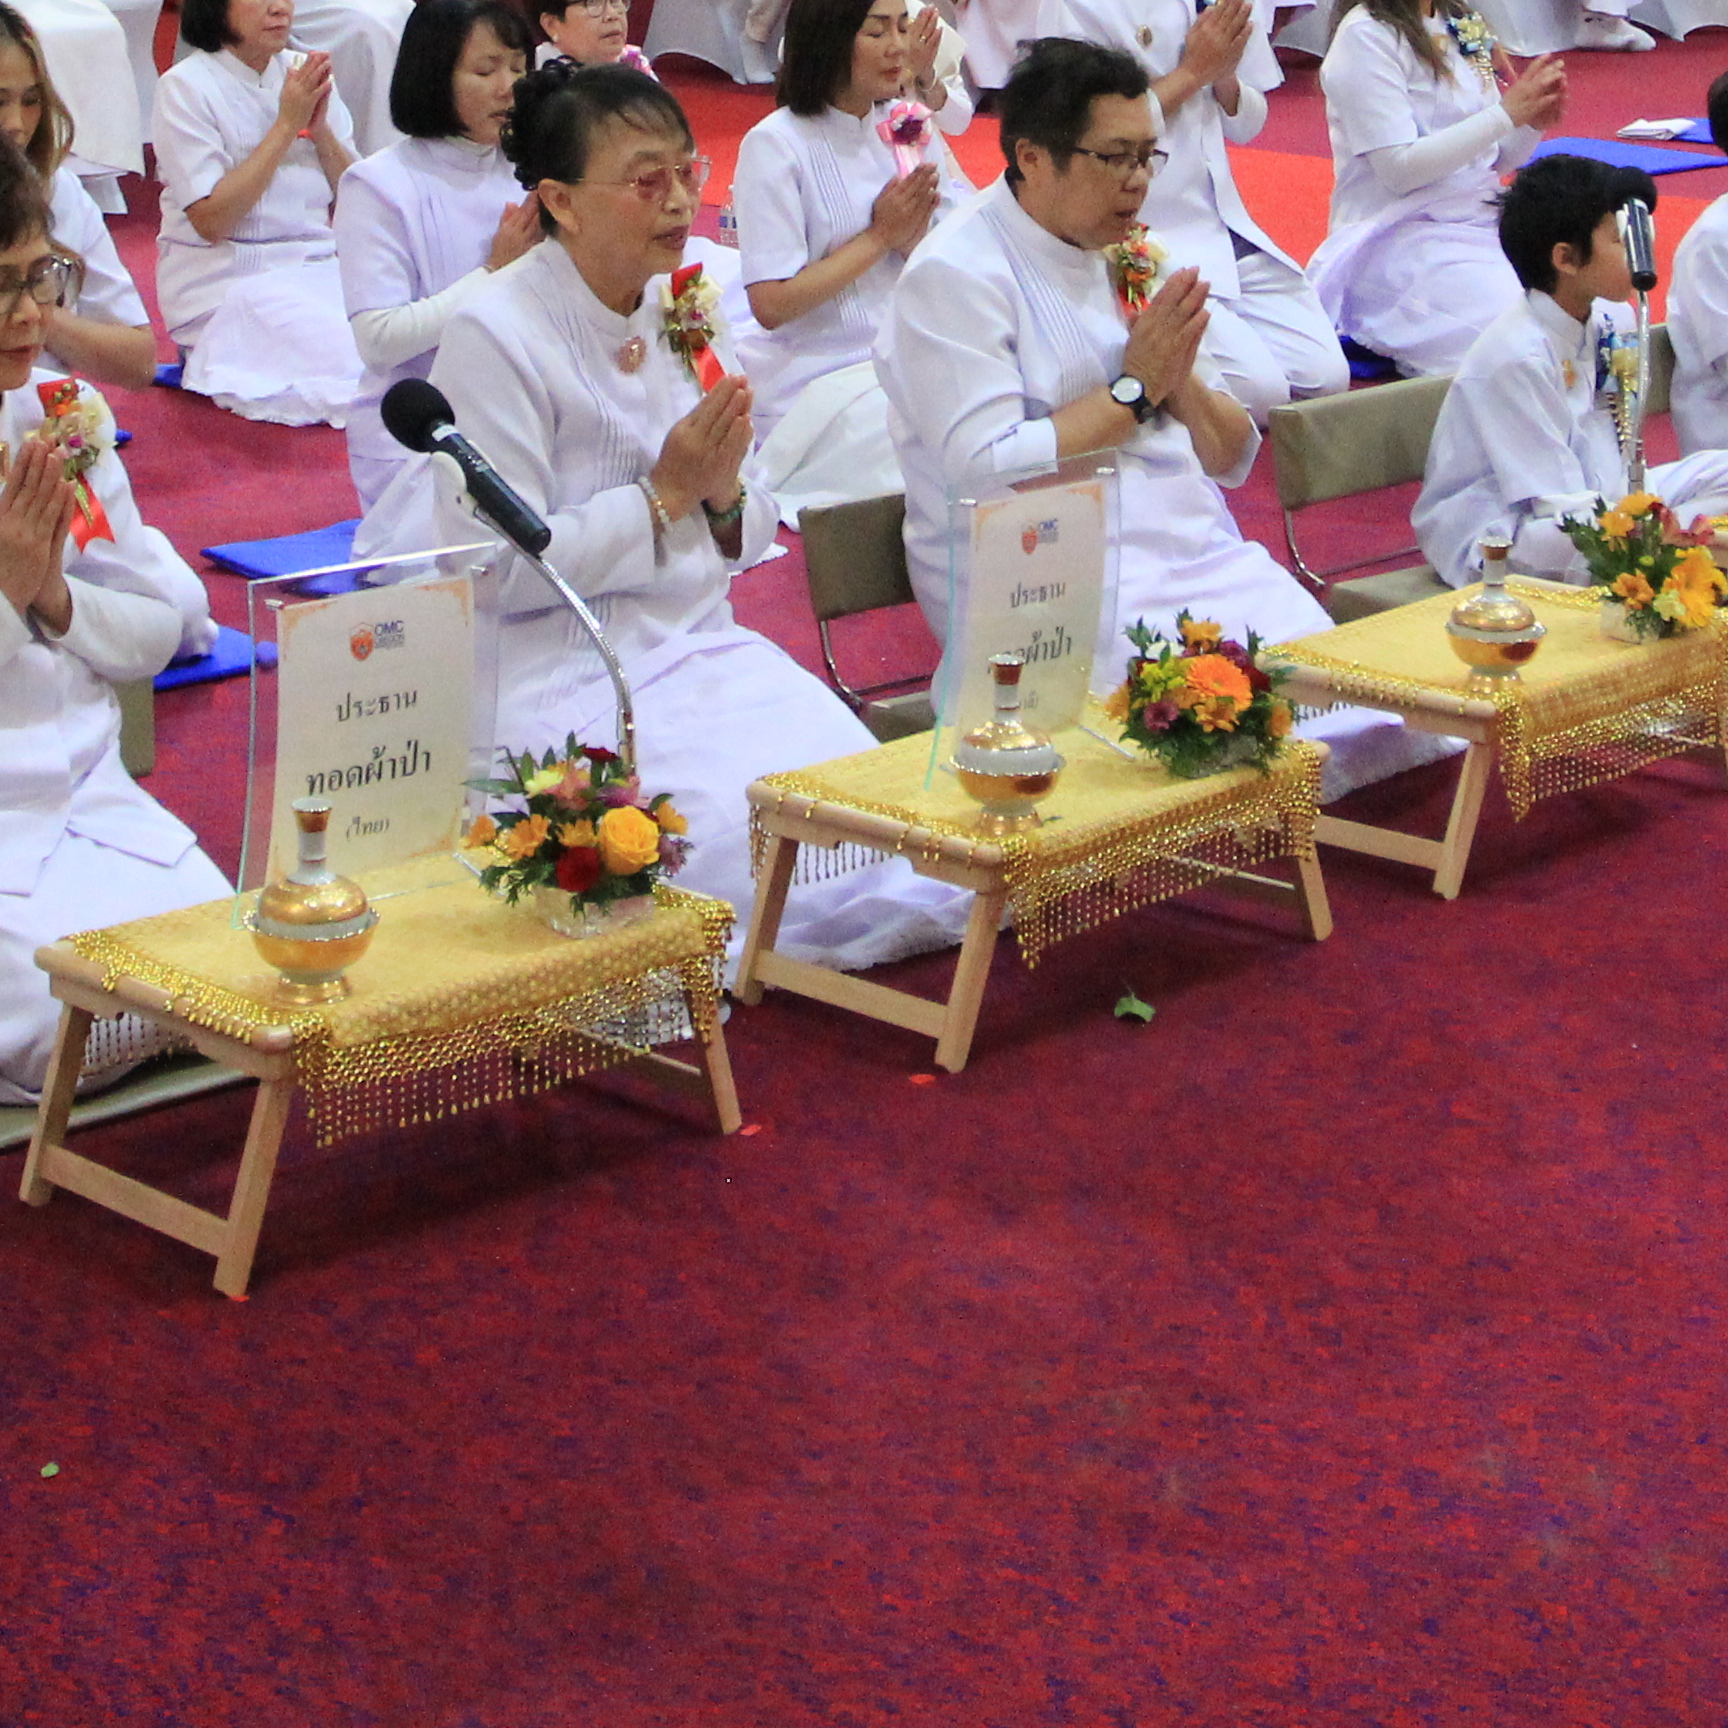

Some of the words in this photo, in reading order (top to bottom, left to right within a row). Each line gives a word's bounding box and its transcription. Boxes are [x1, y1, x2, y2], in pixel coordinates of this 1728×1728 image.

[1010, 580, 1066, 609] ประธาน
[374, 620, 404, 636] OMC
[336, 690, 418, 723] ประธาน
[306, 739, 432, 796] ทอดผ้าป่า
